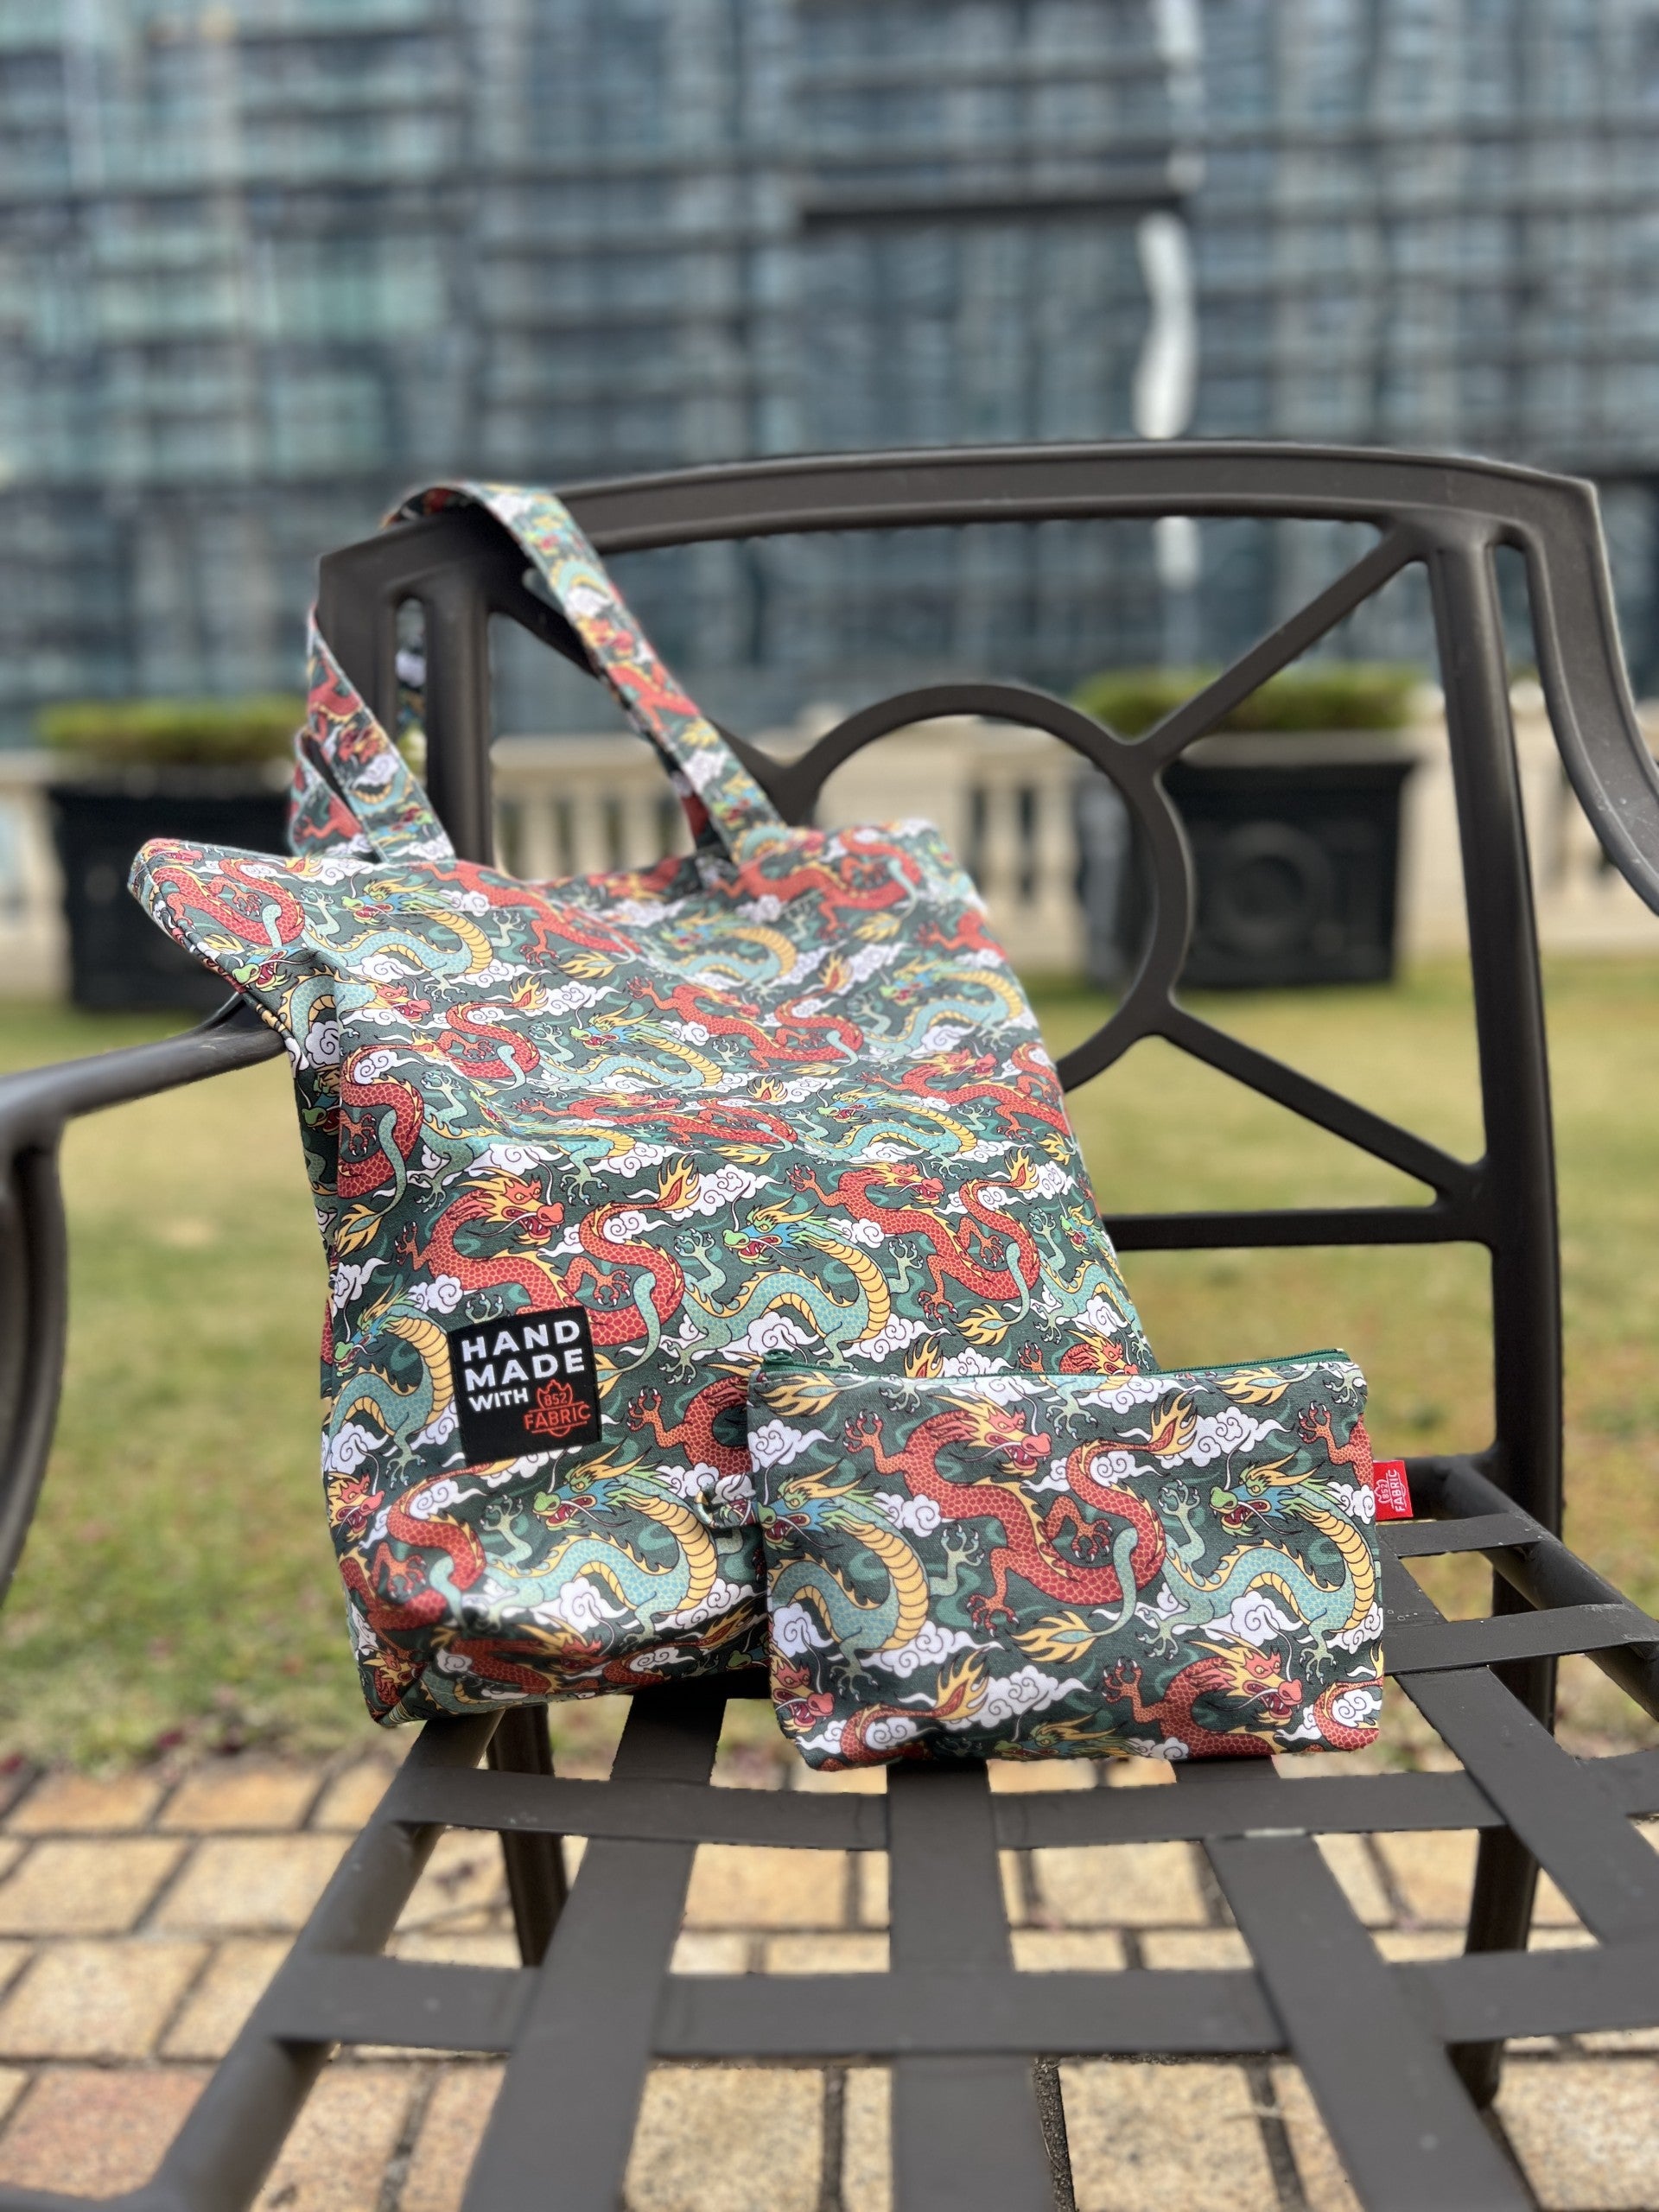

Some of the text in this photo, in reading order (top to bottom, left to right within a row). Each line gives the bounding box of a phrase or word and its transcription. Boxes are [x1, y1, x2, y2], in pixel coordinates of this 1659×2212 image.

[461, 1319, 581, 1363] HAND
[464, 1348, 585, 1392] MADE
[468, 1387, 530, 1412] WITH
[543, 1393, 568, 1406] 852
[523, 1403, 592, 1430] FABRIC
[1380, 1483, 1390, 1499] 852
[1388, 1469, 1406, 1513] FABRIC
